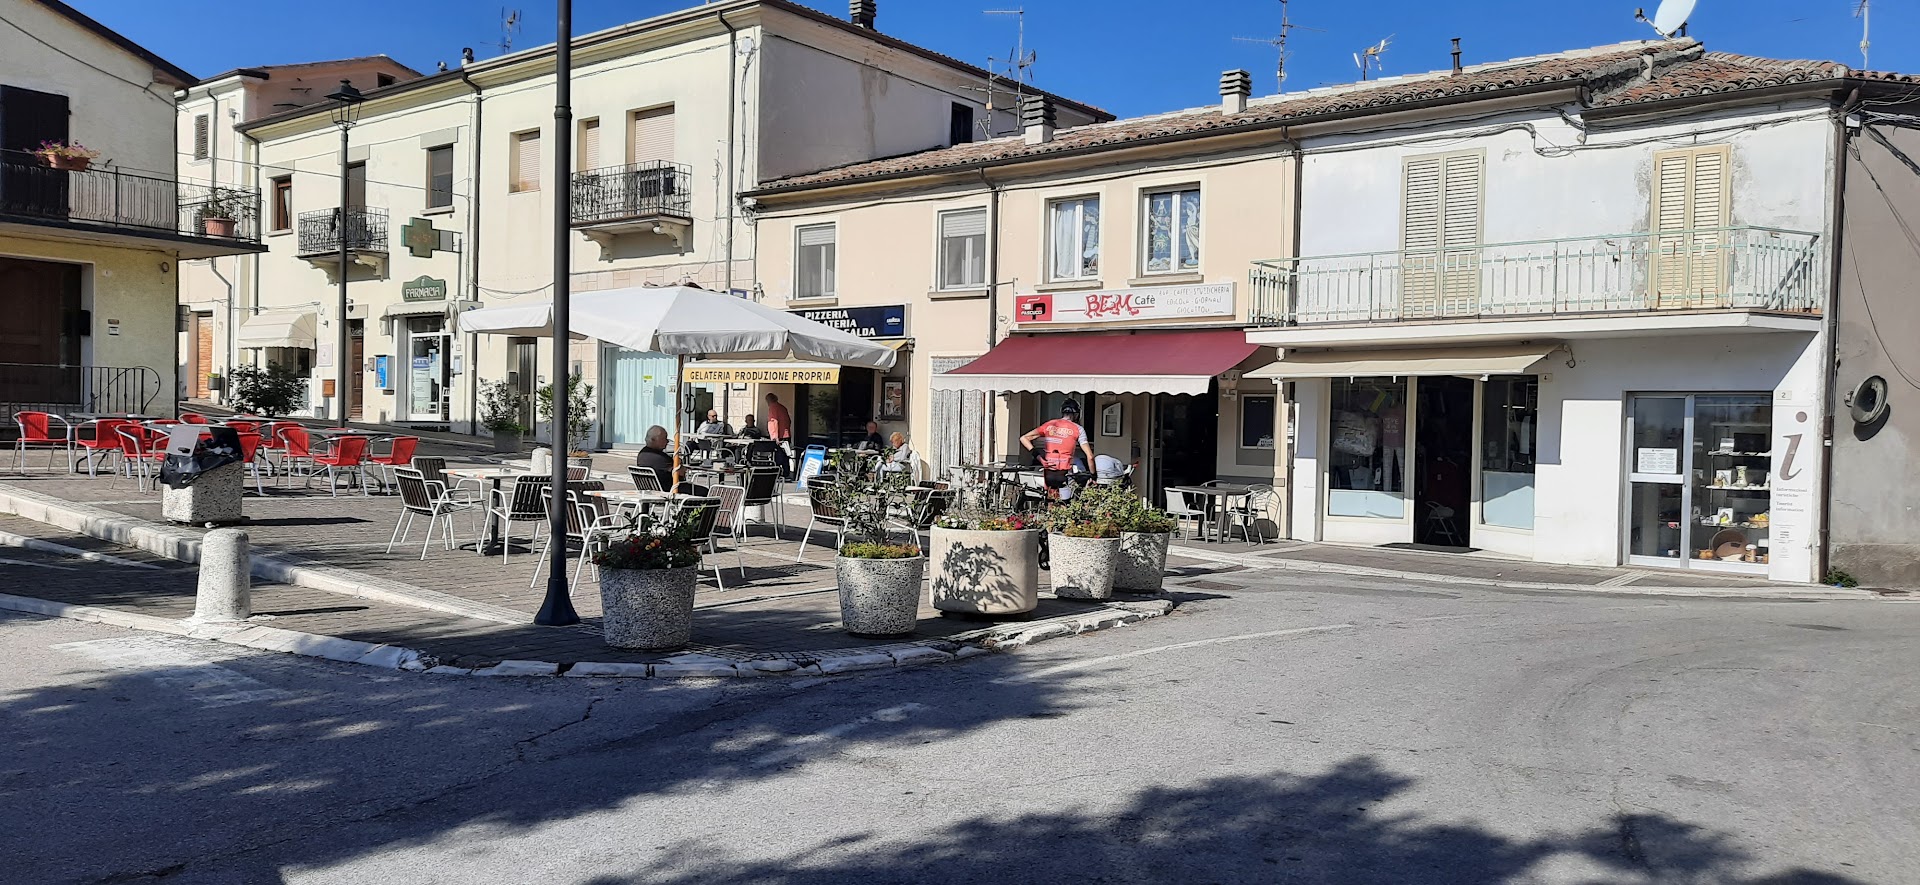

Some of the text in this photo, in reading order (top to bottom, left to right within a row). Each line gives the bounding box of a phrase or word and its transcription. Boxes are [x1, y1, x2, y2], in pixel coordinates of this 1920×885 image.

[405, 286, 440, 298] FARMACIA
[1085, 294, 1156, 319] BEM Cafè
[804, 310, 849, 320] PIZZERIA
[815, 319, 857, 328] ATERIA
[690, 371, 831, 381] GELATERIA PRODUZIONE PROPRIA
